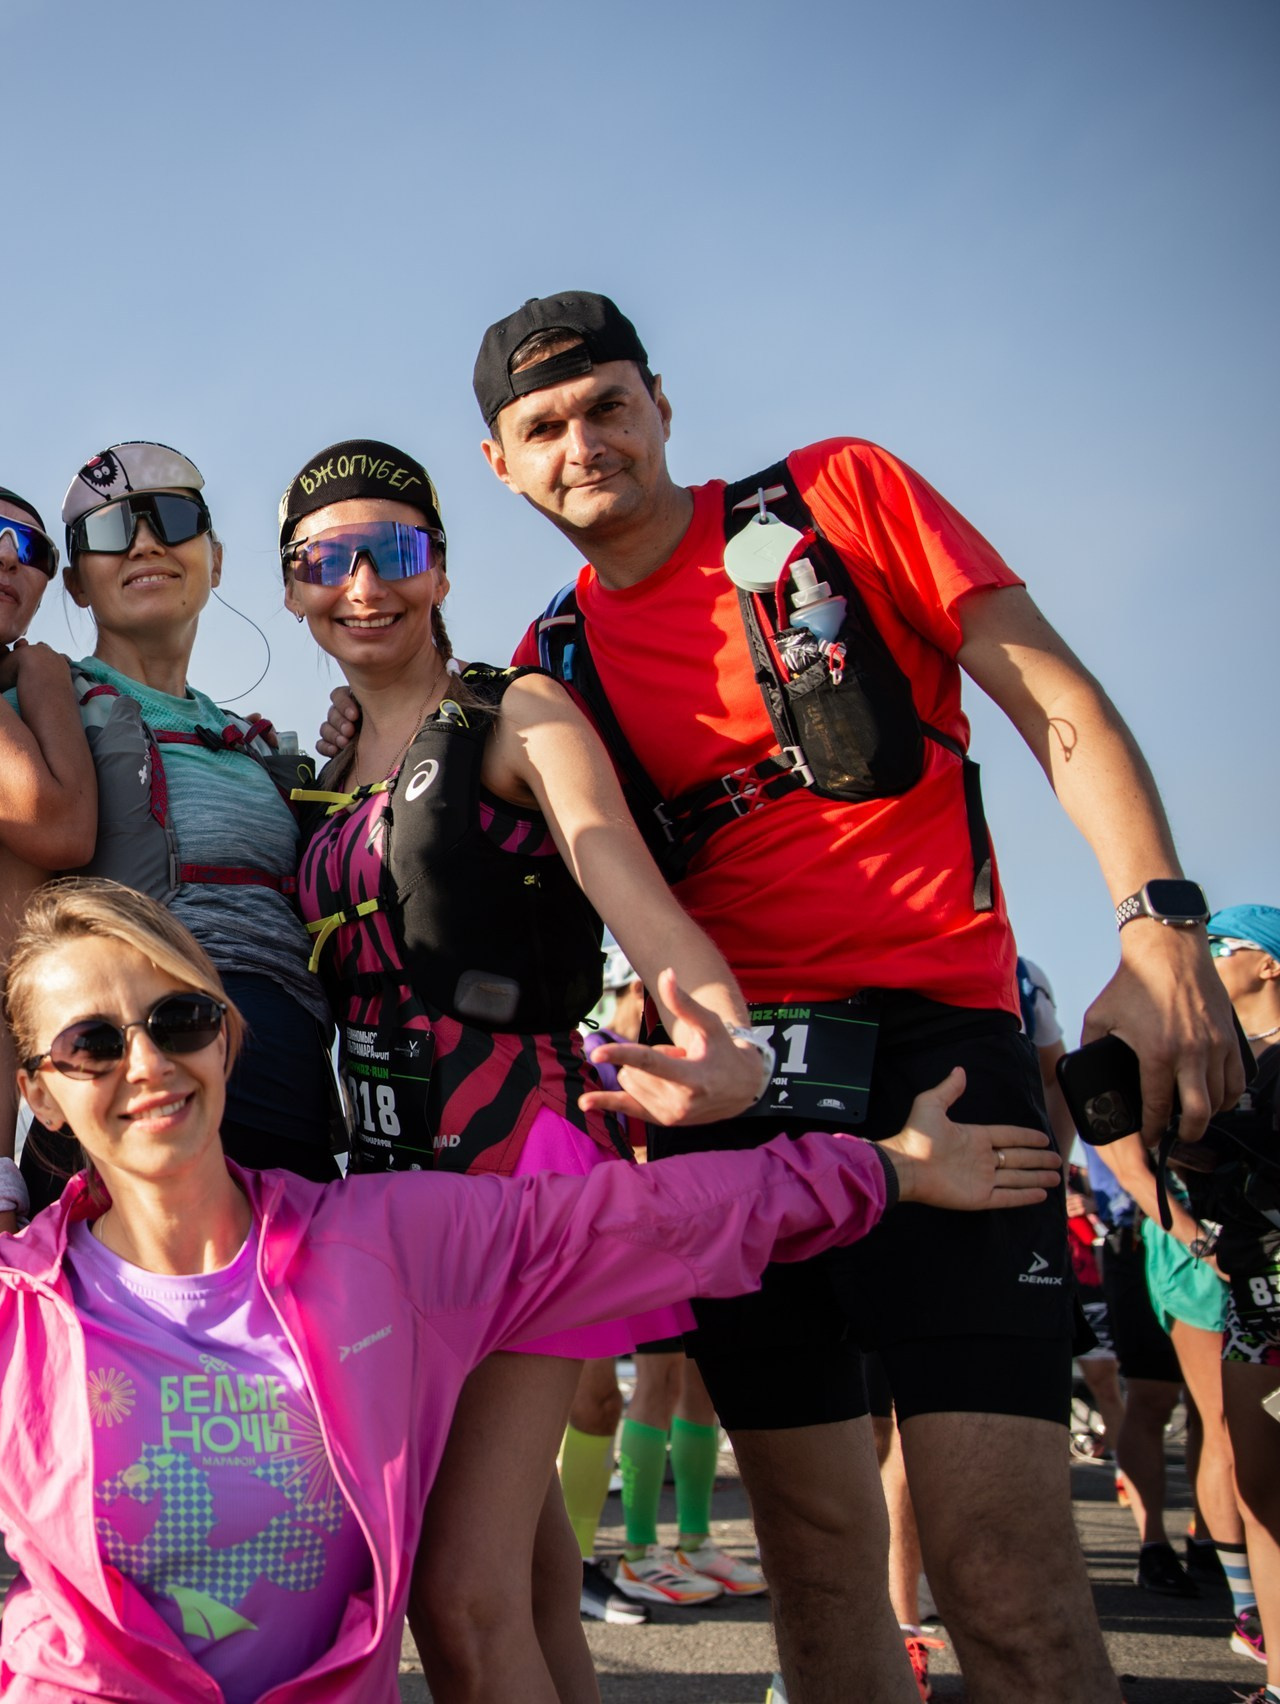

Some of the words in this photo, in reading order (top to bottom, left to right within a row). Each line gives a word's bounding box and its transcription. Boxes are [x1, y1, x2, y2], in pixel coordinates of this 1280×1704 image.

[300, 455, 422, 495] ВЖОПУБЕГ
[1018, 1274, 1063, 1285] DEMIX
[352, 1325, 393, 1353] DEMIX
[160, 1374, 287, 1413] БЕЛЫЕ
[162, 1411, 292, 1454] НОЧИ
[202, 1456, 256, 1467] МАРАФОН
